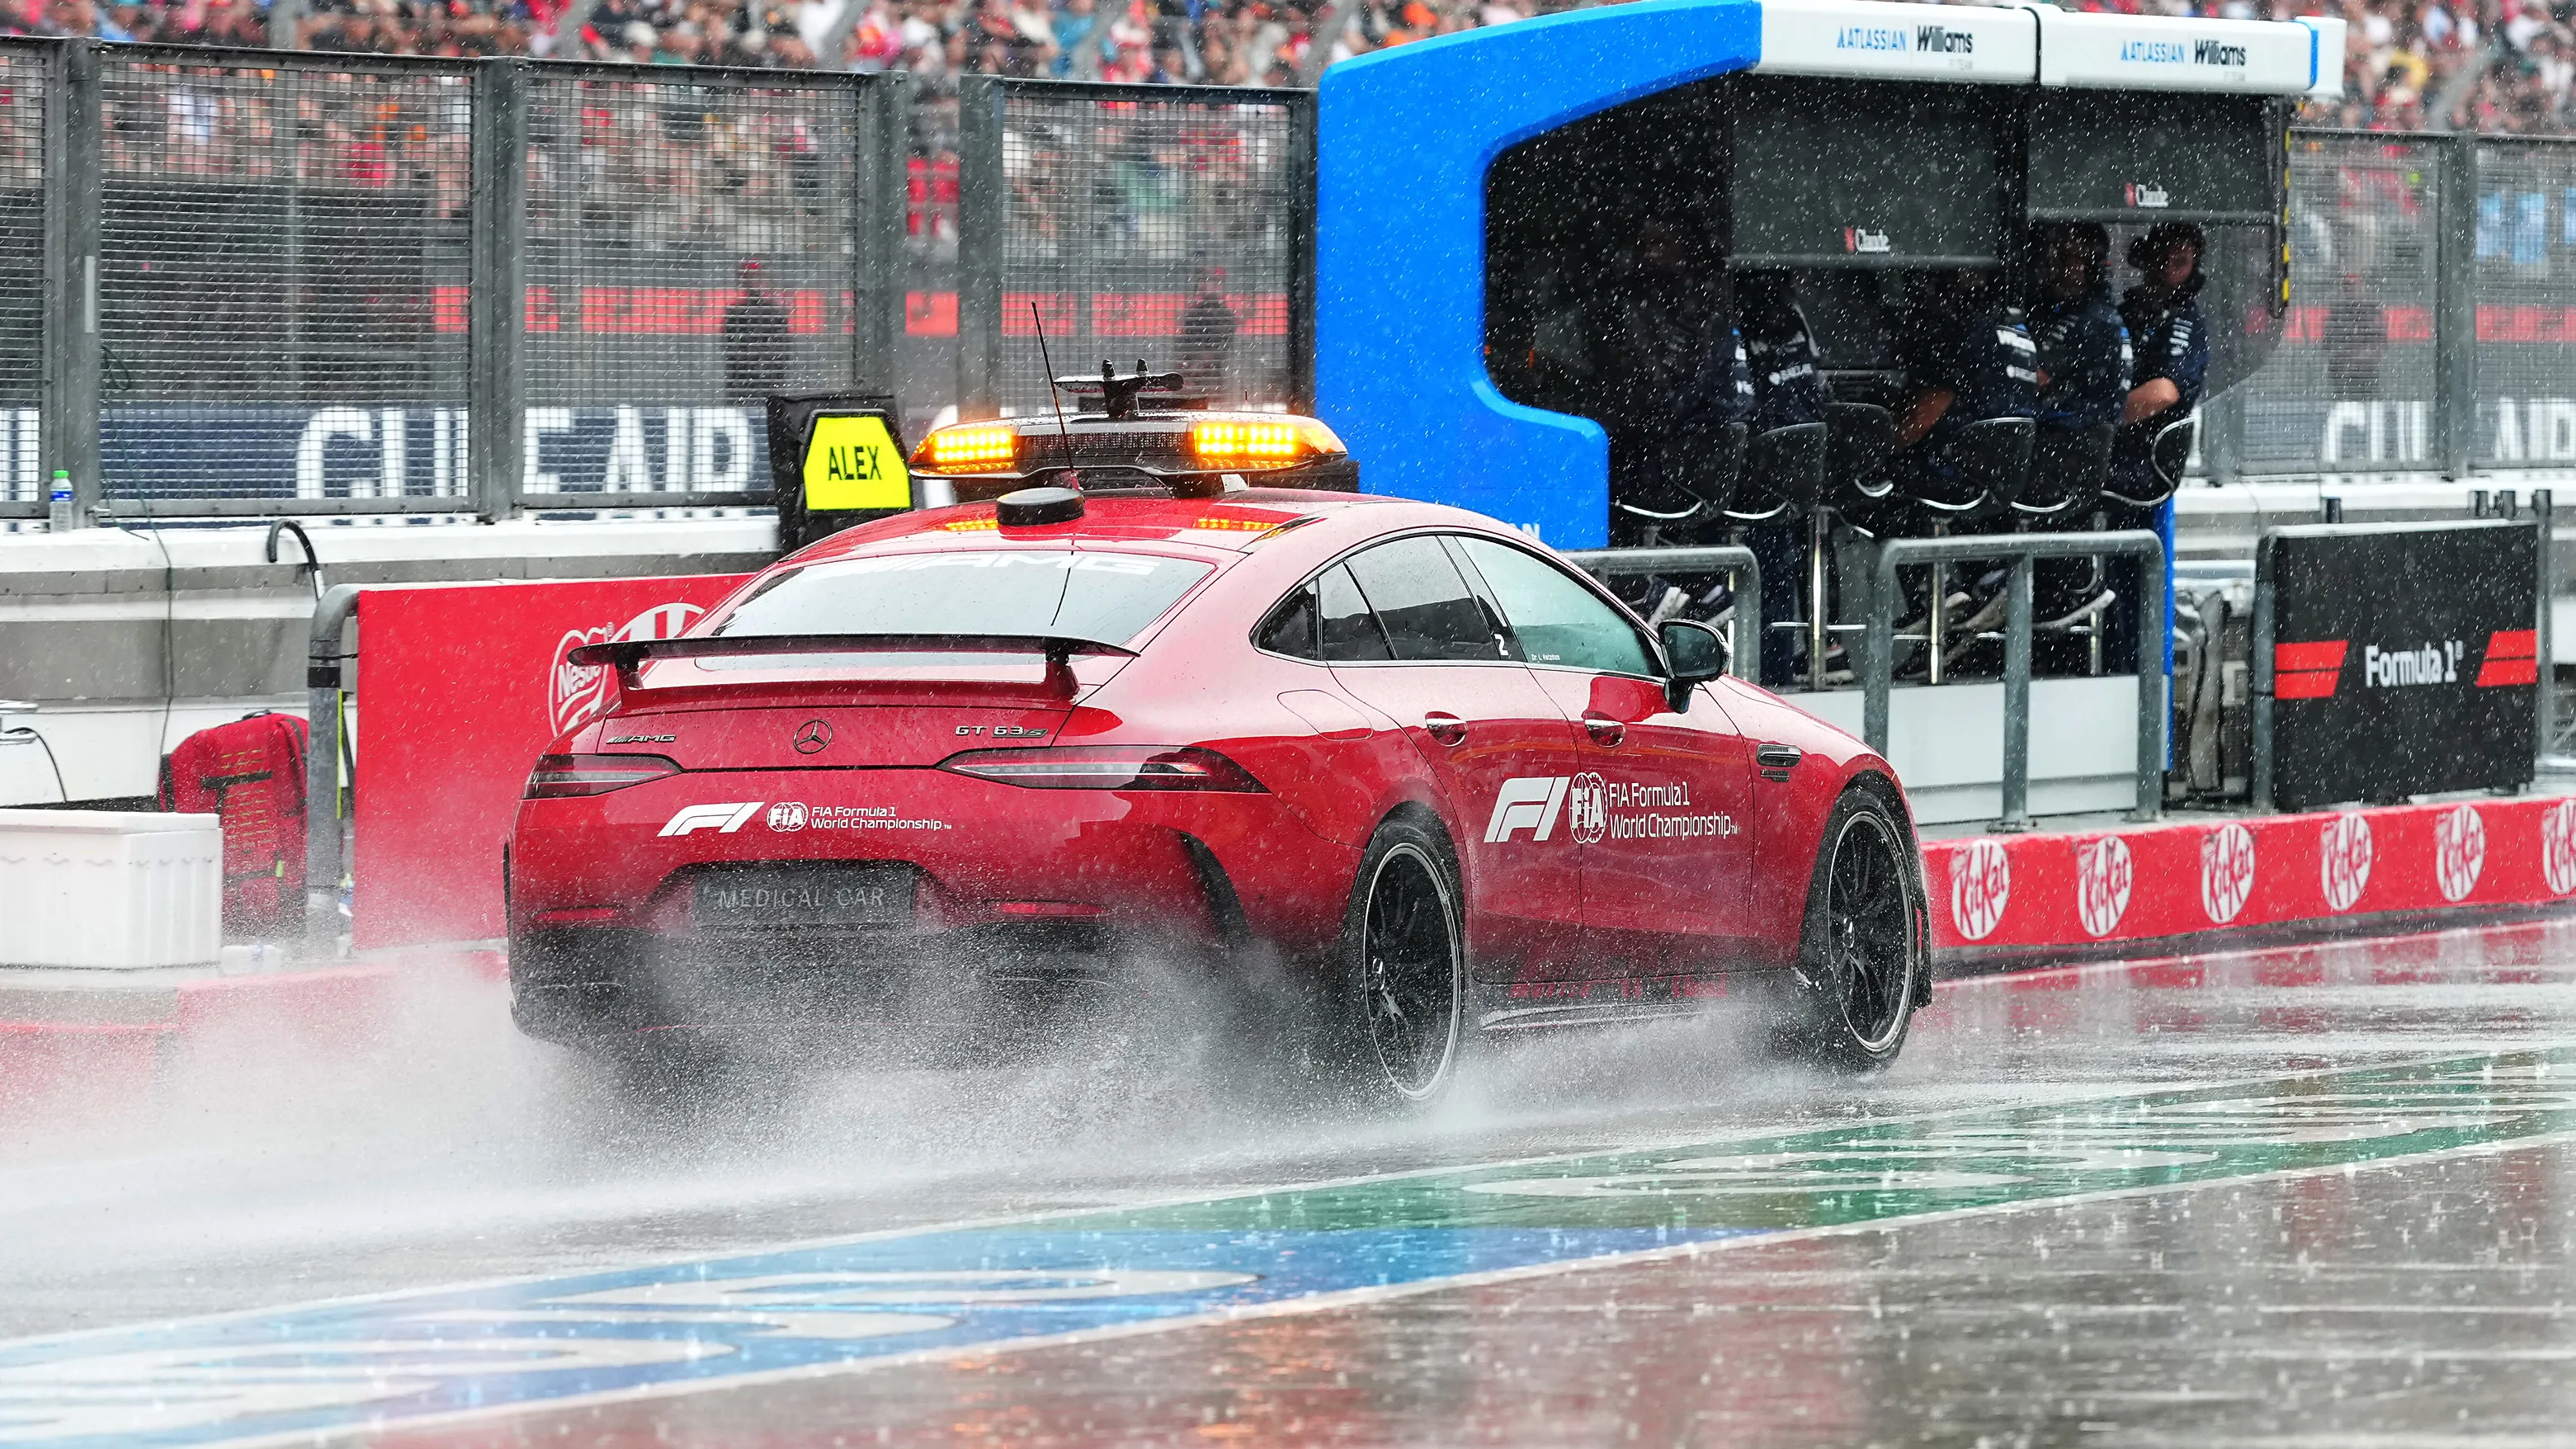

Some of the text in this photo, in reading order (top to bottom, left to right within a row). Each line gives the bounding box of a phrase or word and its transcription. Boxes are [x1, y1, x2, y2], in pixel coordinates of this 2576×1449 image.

[1847, 27, 1907, 51] ATLASSIAN
[2130, 41, 2185, 63] ATLASSIAN
[2195, 39, 2246, 66] Williams
[828, 446, 882, 481] ALEX
[1494, 633, 1509, 656] 2
[2365, 641, 2442, 688] Formula
[625, 734, 677, 743] AMG
[955, 725, 987, 736] GT
[1609, 781, 1691, 808] FIA Formula 1
[810, 818, 849, 829] World
[811, 806, 897, 817] FIA Formula 1
[1610, 814, 1646, 840] World
[2328, 817, 2370, 908] KitKat
[2443, 809, 2481, 898] KitKat
[2085, 841, 2129, 933] KitKat
[2208, 828, 2251, 920] KitKat
[718, 887, 885, 909] MEDICAL CAR
[1960, 844, 2006, 937] KitKat
